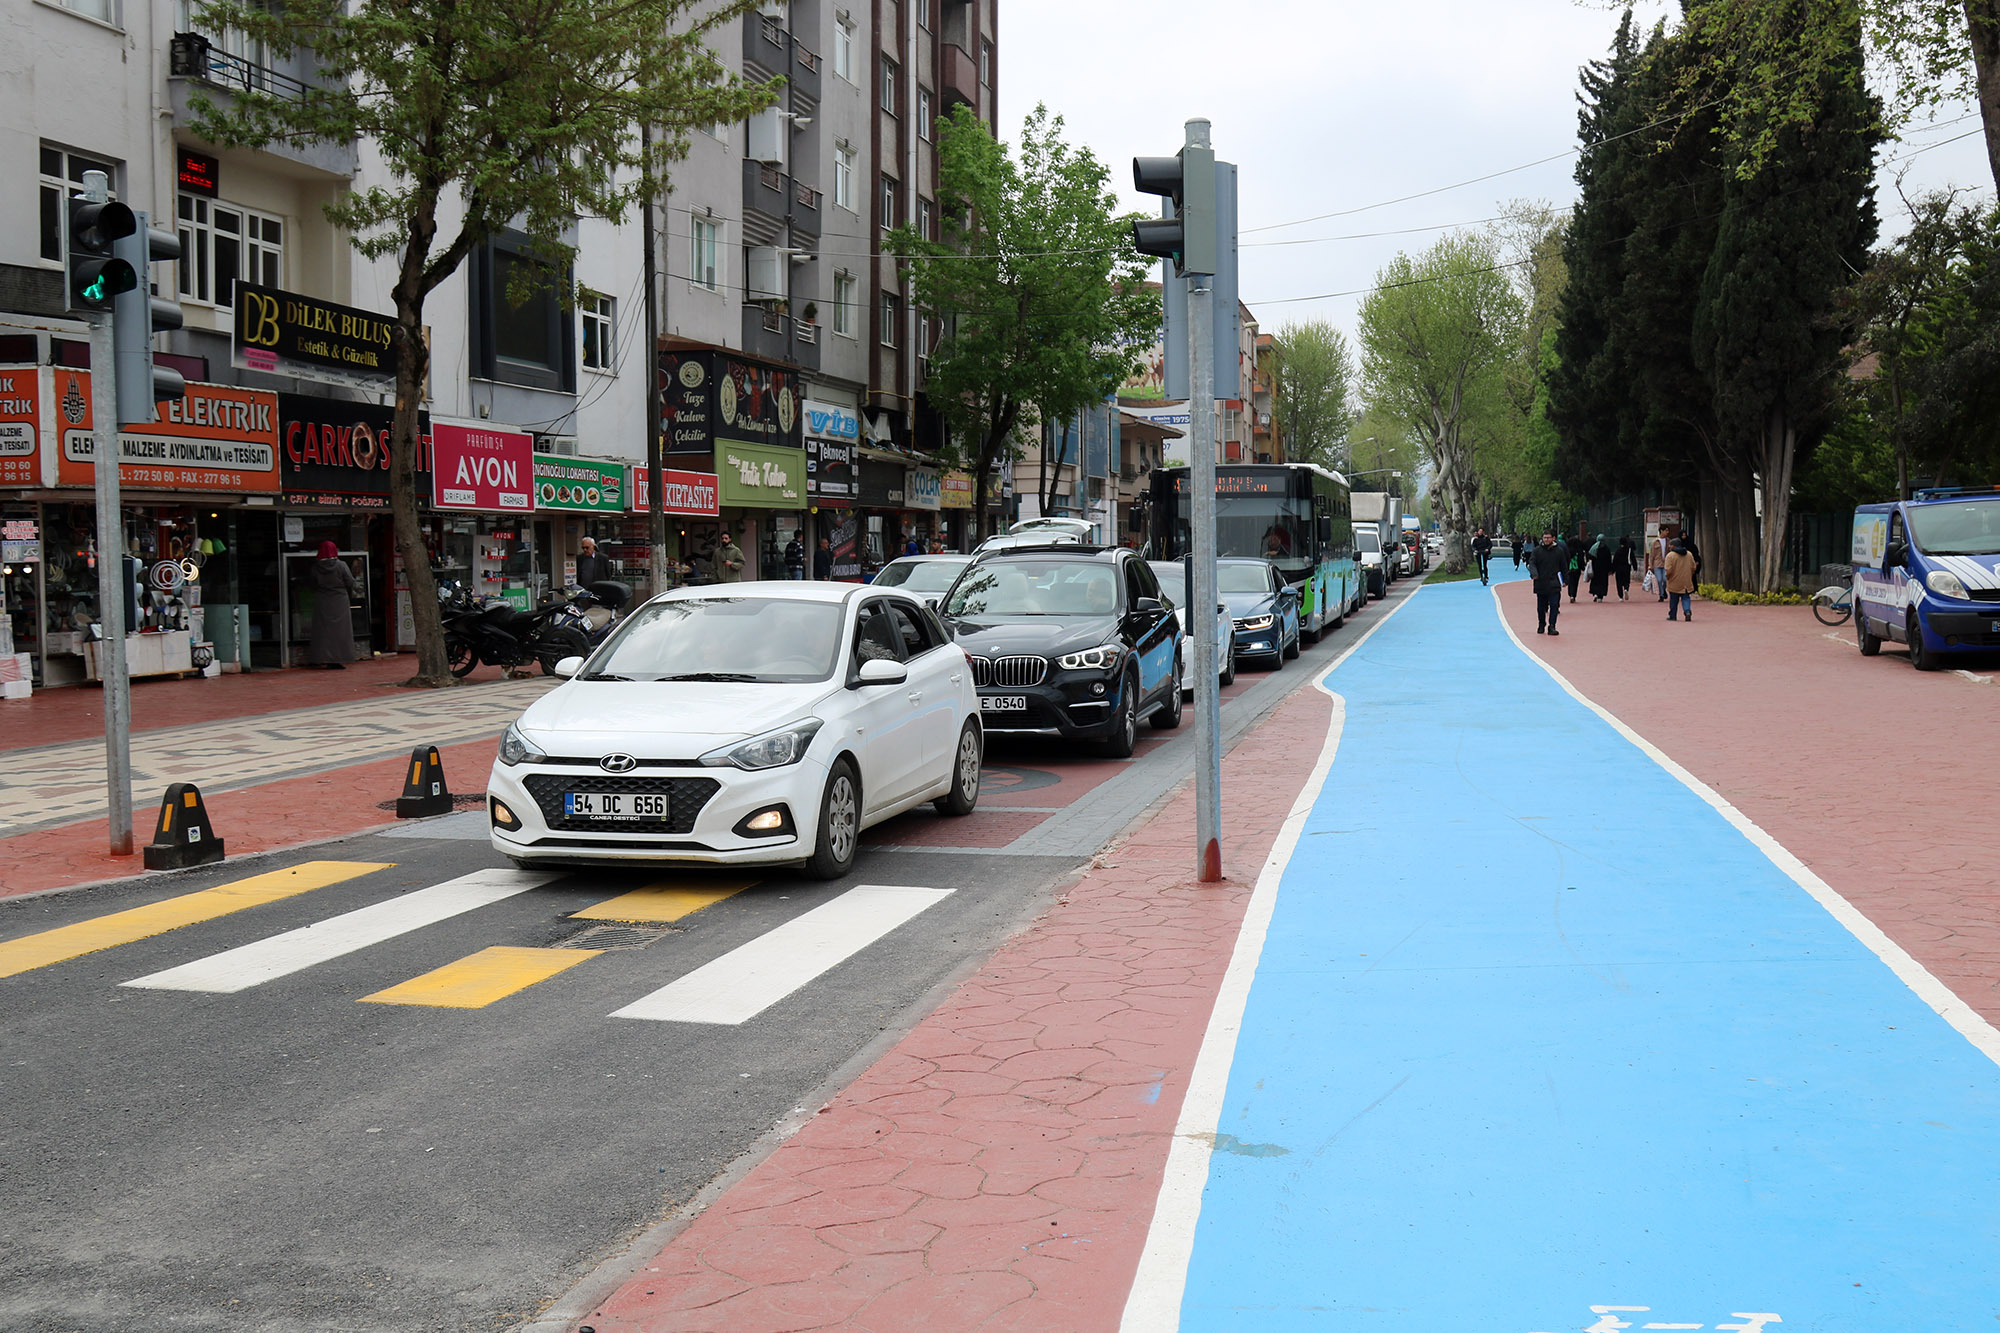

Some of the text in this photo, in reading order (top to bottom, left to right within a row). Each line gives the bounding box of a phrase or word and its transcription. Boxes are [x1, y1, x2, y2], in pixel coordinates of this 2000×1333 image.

[341, 313, 392, 350] BULUŞ
[297, 336, 329, 357] Estetik
[342, 346, 379, 367] Güzellik
[683, 391, 705, 407] Taze
[169, 395, 272, 433] ELEKTRİK
[674, 410, 705, 422] Kahve
[675, 429, 706, 445] Çekilir
[123, 440, 166, 459] MALZEME
[169, 443, 222, 462] AYDINLATMA
[223, 450, 234, 462] ve
[234, 445, 269, 465] TESİSATI
[4, 462, 16, 470] 50
[18, 461, 31, 469] 60
[455, 455, 517, 488] AVON
[5, 472, 31, 480] 96 15
[133, 469, 149, 481] 272
[151, 470, 162, 481] 50
[164, 471, 174, 482] 60
[181, 471, 197, 483] FAX
[204, 472, 218, 484] 277
[220, 473, 231, 485] 96
[232, 474, 241, 485] 15
[665, 479, 714, 509] KIRTASİYE
[995, 697, 1024, 708] 0540
[575, 795, 593, 813] 54
[602, 795, 621, 814] DC
[634, 796, 664, 814] 656
